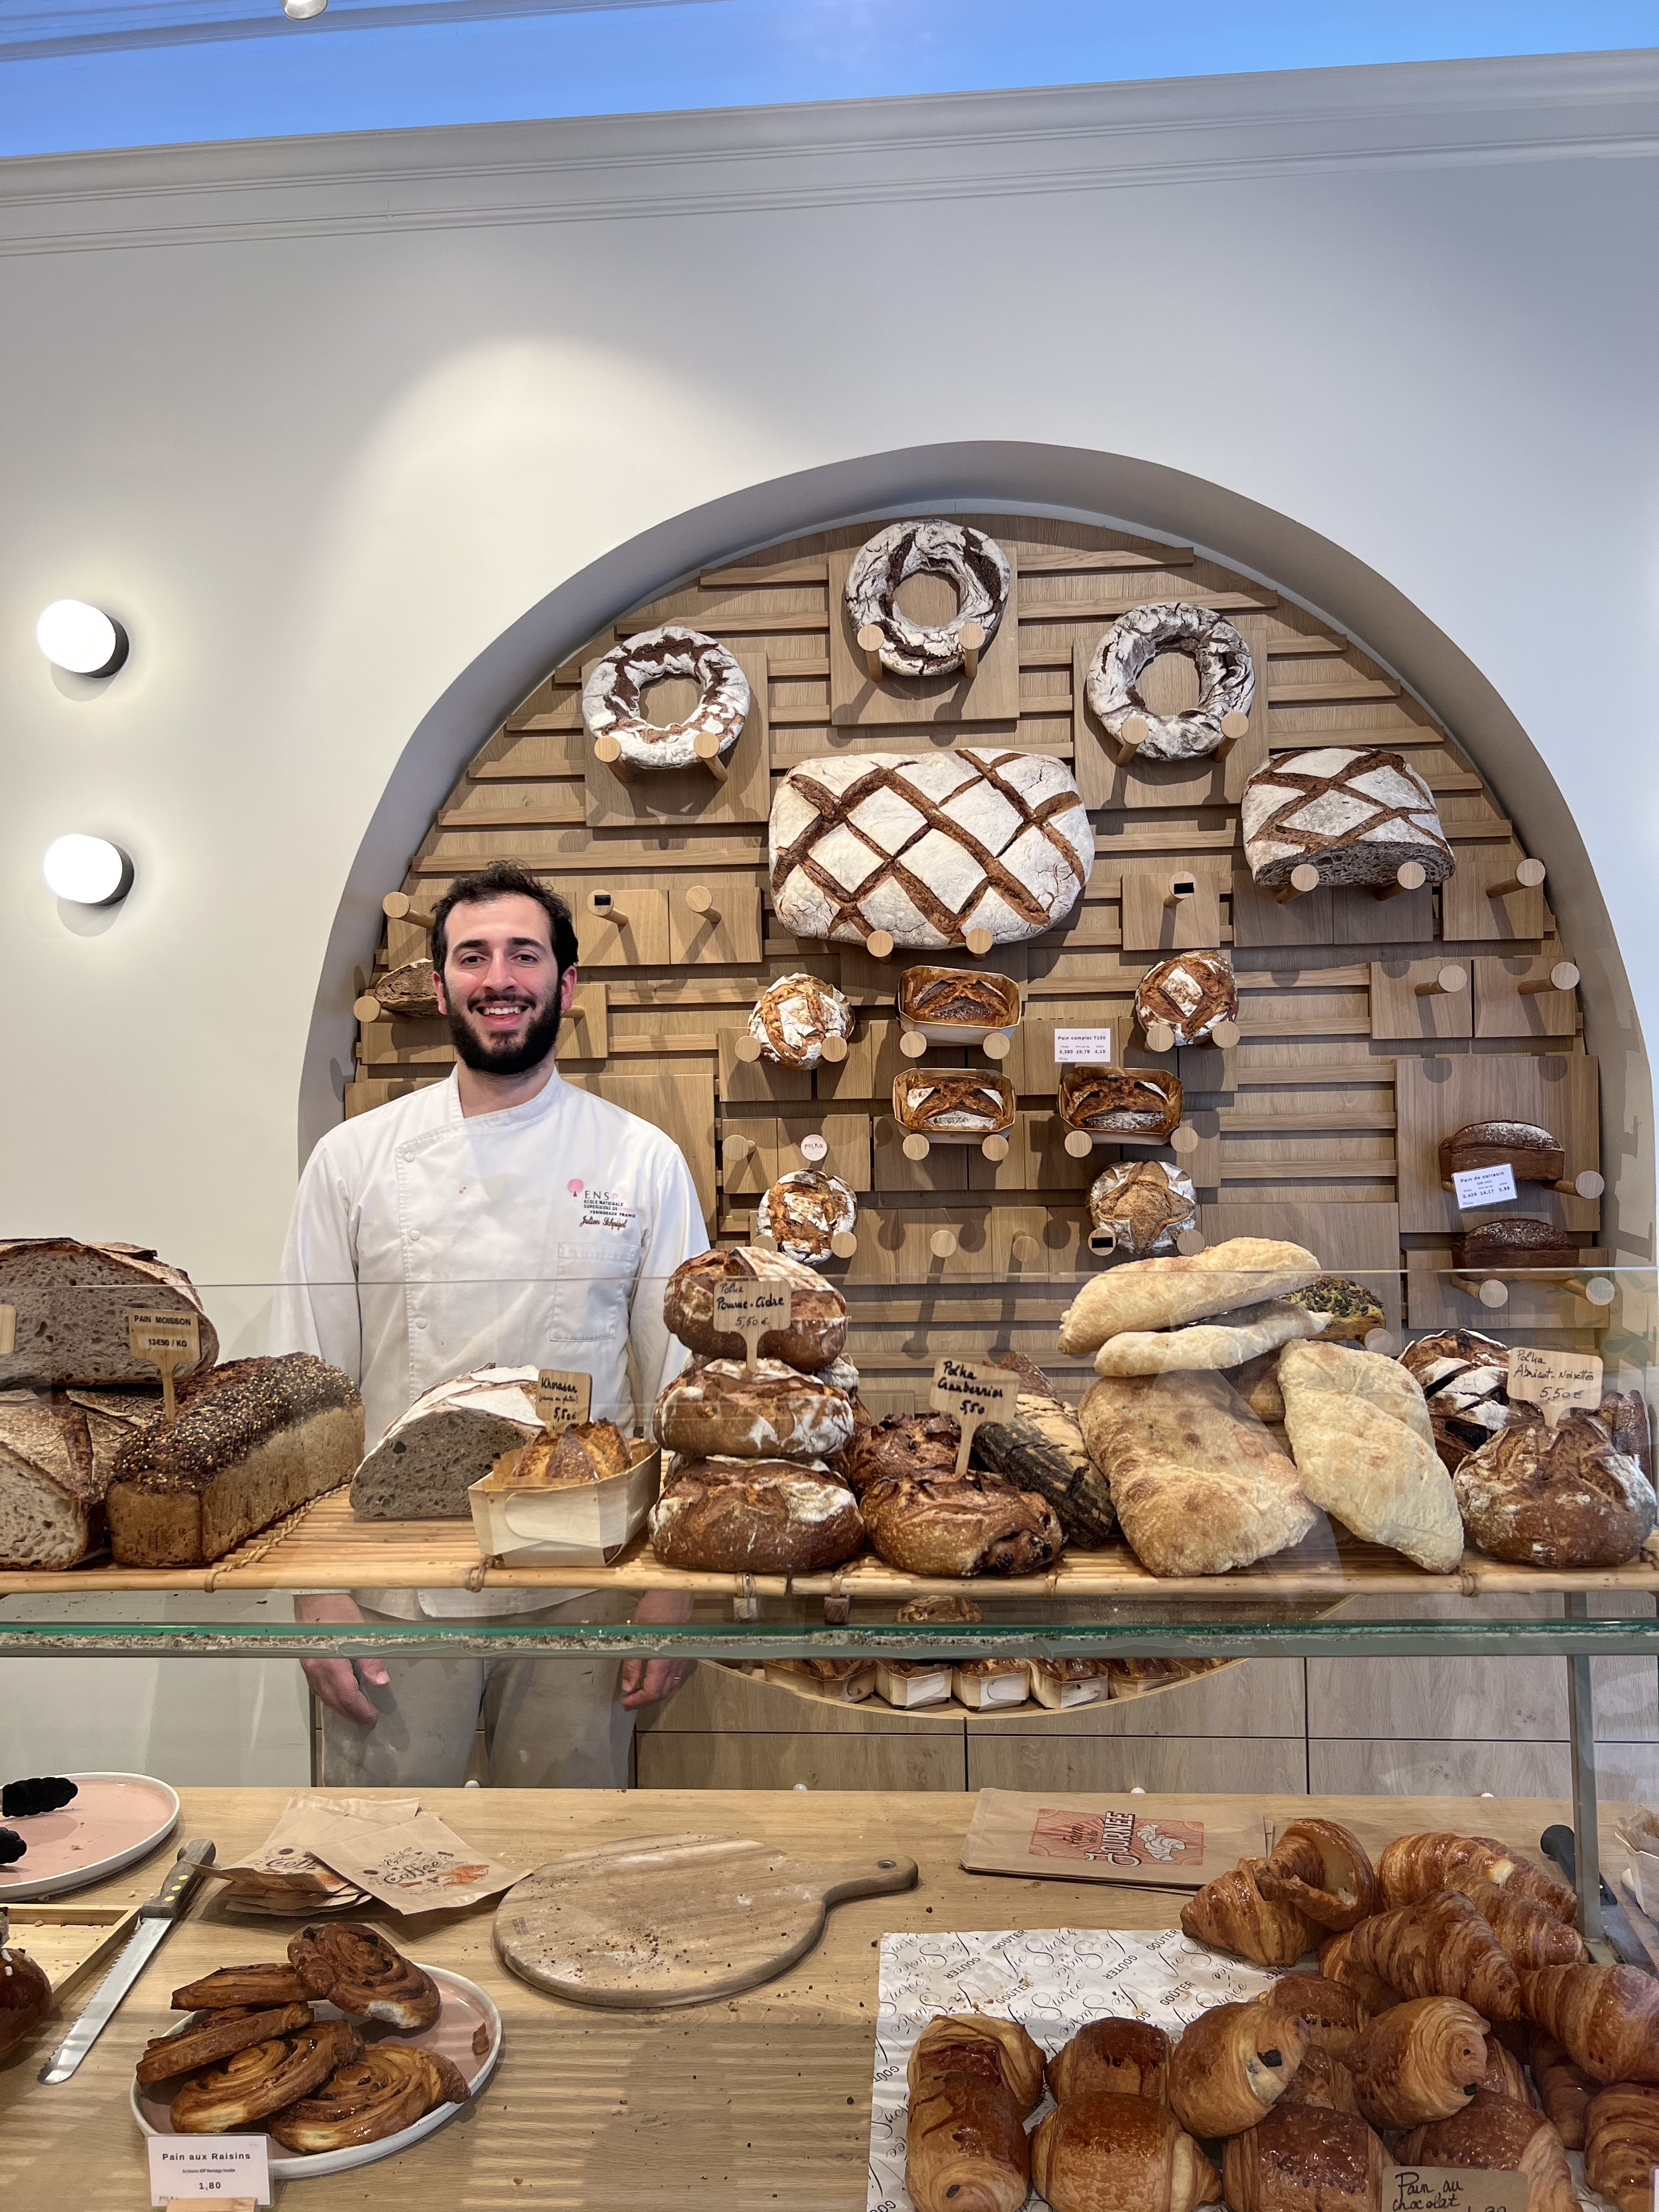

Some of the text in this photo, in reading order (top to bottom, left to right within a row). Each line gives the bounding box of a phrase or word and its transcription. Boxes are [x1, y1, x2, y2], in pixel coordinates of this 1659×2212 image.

[716, 1293, 785, 1310] Pomme Cidre
[134, 1315, 191, 1325] PAIN MOISSON
[1517, 1350, 1546, 1364] Polka
[943, 1360, 977, 1380] Polka
[541, 1377, 578, 1393] Khorasan
[960, 1400, 985, 1415] 5,50
[1084, 1810, 1142, 1867] JOURNÉE
[383, 1861, 441, 1884] Coffee
[992, 1929, 1028, 1950] GOÛTER
[1146, 1929, 1181, 1951] GOÛTER
[943, 1957, 981, 1979] GOÛTER
[988, 1950, 1027, 1980] Vie
[1102, 1955, 1138, 1979] GOÛTER
[1144, 1950, 1184, 1978] Vie
[996, 1983, 1034, 2004] GOÛTER
[1029, 1980, 1085, 2022] Sucrée
[1160, 1980, 1197, 2006] GOÛTER
[212, 2152, 251, 2160] Raisins
[199, 2181, 221, 2191] 1,80
[1395, 2171, 1464, 2198] Pain au
[1392, 2192, 1461, 2212] chocolat
